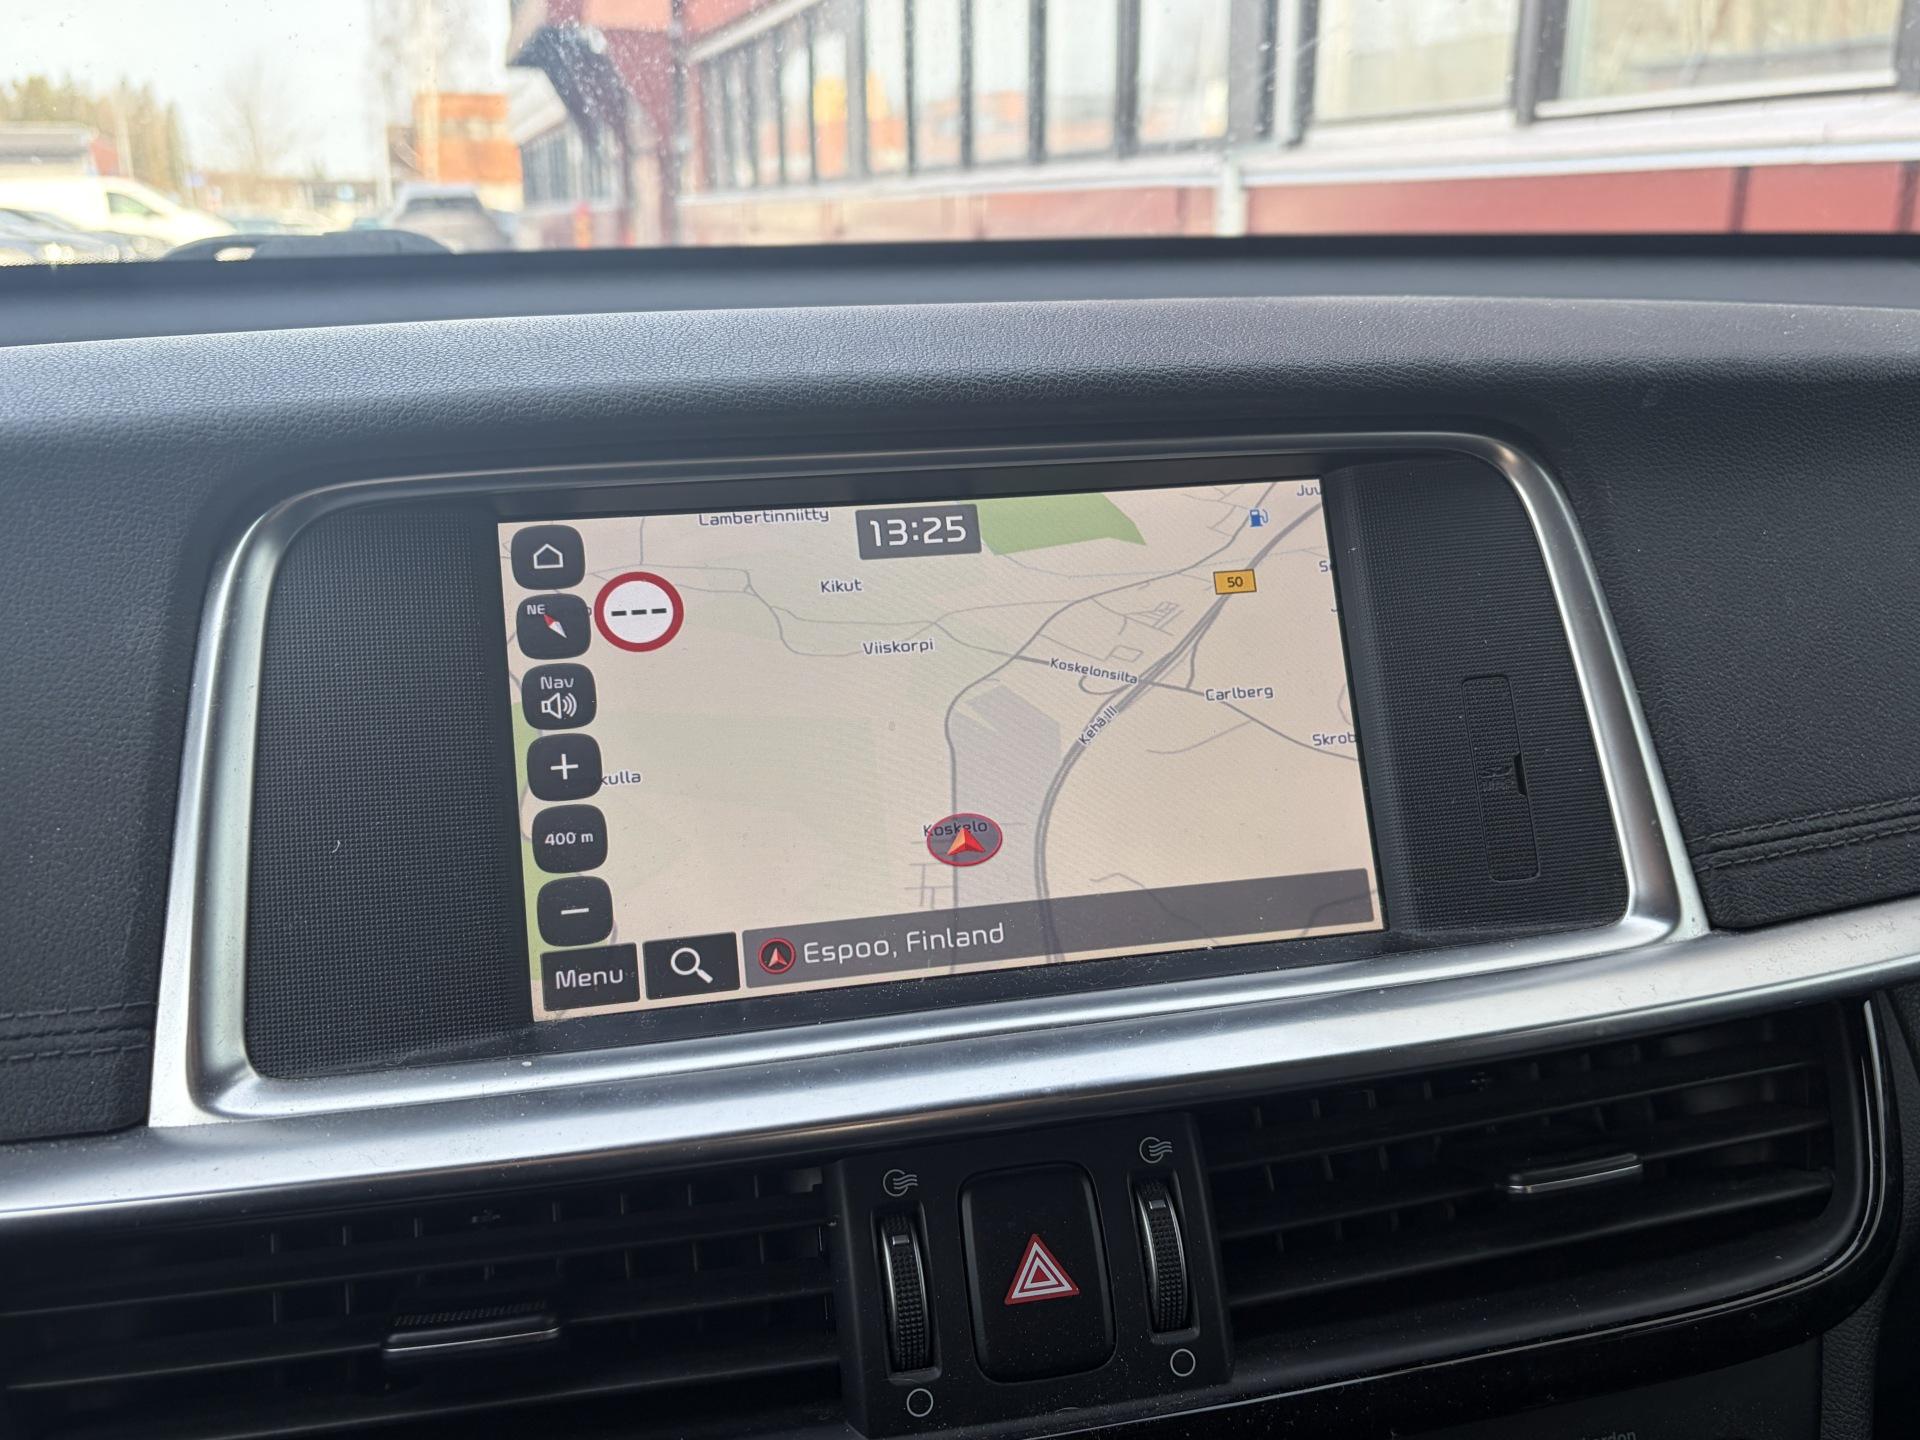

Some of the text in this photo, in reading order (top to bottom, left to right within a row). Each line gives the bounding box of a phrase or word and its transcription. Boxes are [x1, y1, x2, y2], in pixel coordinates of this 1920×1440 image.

[699, 508, 829, 526] Lambertinniitty
[870, 515, 967, 547] 13:25
[820, 579, 863, 593] Kikut
[1227, 576, 1244, 588] 50
[526, 604, 546, 615] NE
[863, 639, 934, 655] Viiskorpi
[1050, 657, 1138, 685] Koskelonsilta
[540, 676, 574, 690] Nav
[1205, 687, 1274, 701] Carlberg
[1078, 716, 1107, 745] Kehä
[545, 832, 594, 846] 400 m
[803, 922, 1004, 964] Espoo, Finland
[555, 969, 624, 990] Menu
